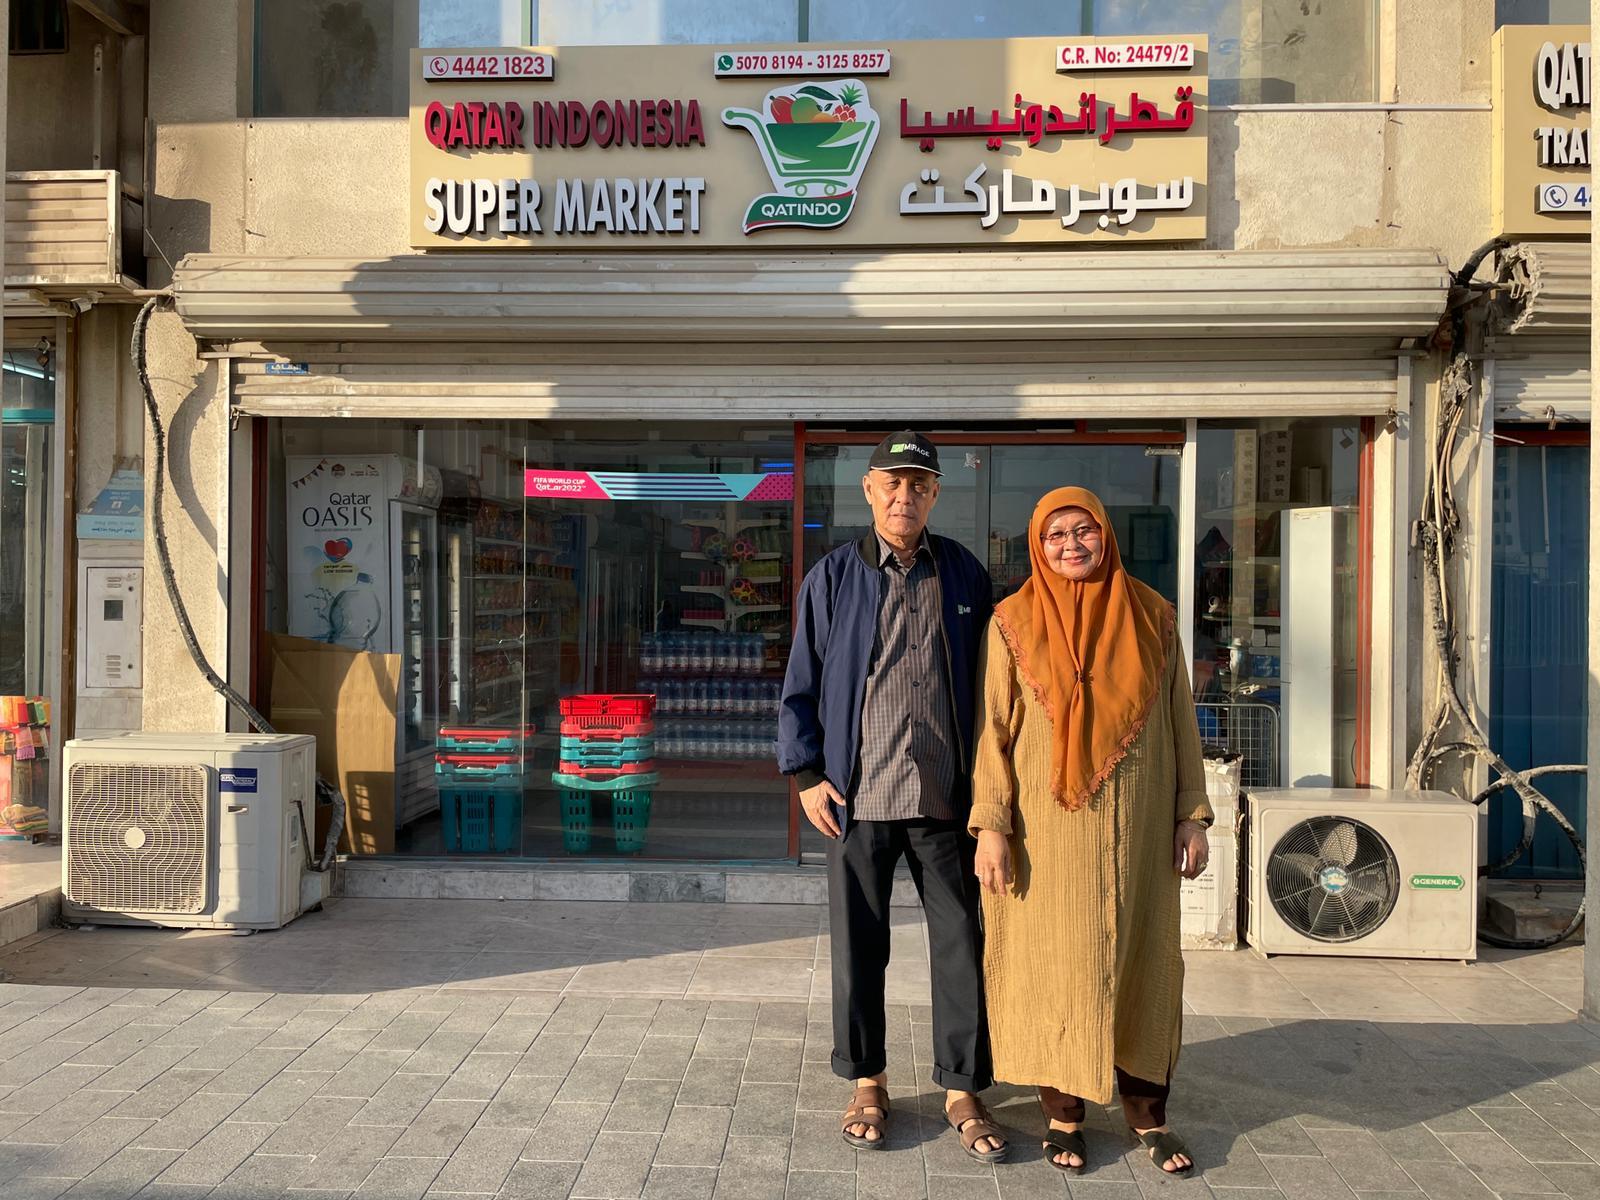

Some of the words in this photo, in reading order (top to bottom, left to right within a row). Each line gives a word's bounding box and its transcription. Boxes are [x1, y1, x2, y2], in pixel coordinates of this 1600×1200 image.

[736, 56, 768, 70] 5070
[771, 55, 803, 69] 8194
[817, 54, 848, 69] 3125
[852, 53, 885, 68] 8257
[1061, 47, 1090, 65] C.R.
[1095, 46, 1121, 64] No:
[1126, 44, 1189, 63] 24479/2
[452, 56, 499, 76] 4442
[504, 55, 545, 75] 1823
[424, 100, 524, 151] QATAR
[533, 99, 705, 148] INDONESIA
[900, 92, 1096, 152] اندونيسيا
[1100, 85, 1194, 145] قطر
[424, 177, 542, 234] SUPER
[553, 177, 705, 233] MARKET
[900, 162, 1057, 229] ماركت
[1061, 176, 1194, 230] سوبر
[1574, 186, 1591, 207] 4
[761, 203, 841, 217] QATINDO
[904, 443, 930, 457] MIRAGE
[329, 492, 372, 506] Qatar
[302, 506, 373, 527] OASIS
